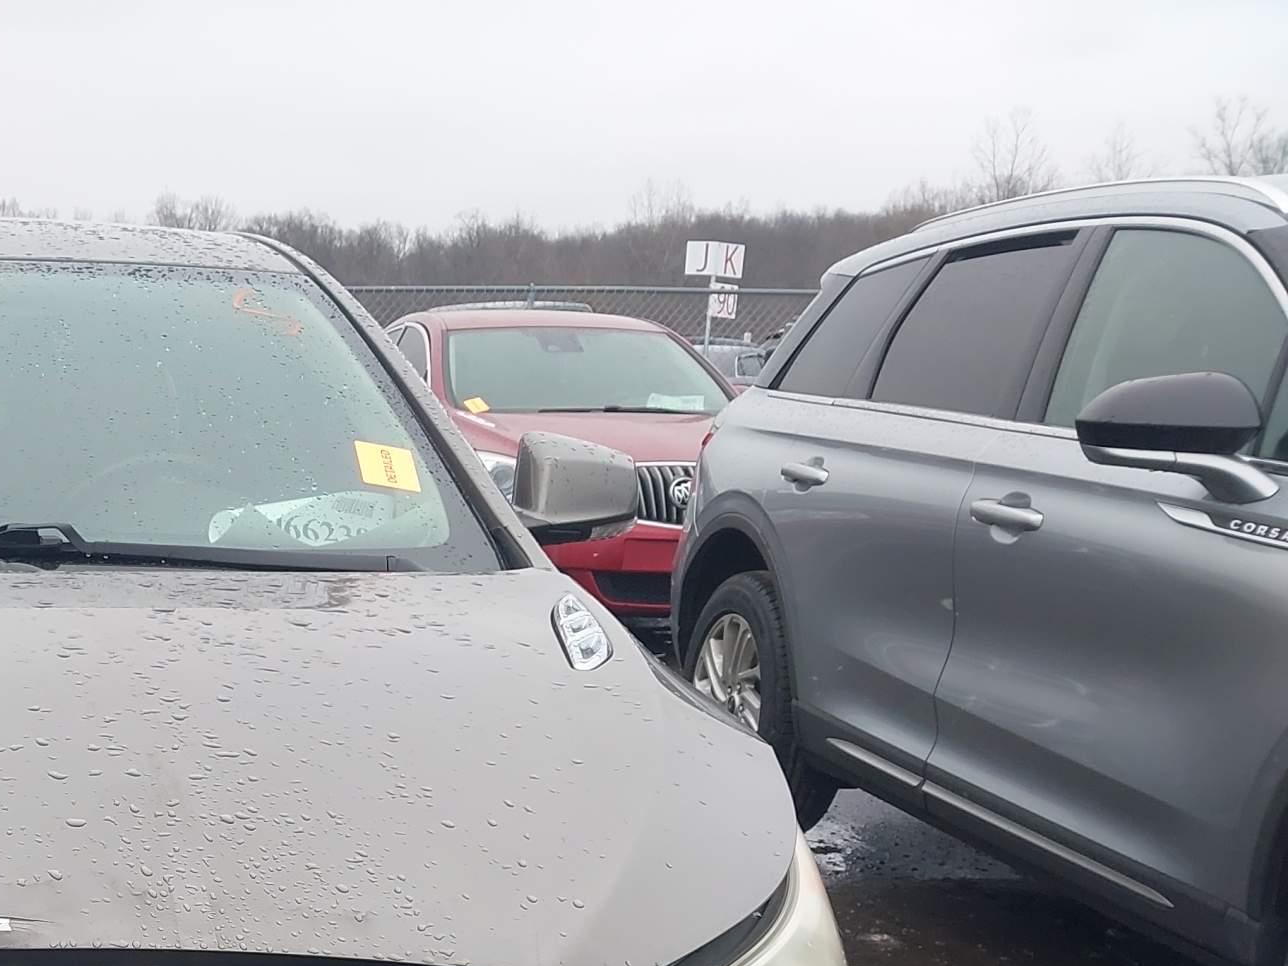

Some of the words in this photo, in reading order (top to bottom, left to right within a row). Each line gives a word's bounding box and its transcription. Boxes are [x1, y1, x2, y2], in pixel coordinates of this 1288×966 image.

[696, 243, 709, 272] J
[723, 245, 739, 275] K
[717, 286, 737, 315] 90
[380, 449, 398, 484] DETAILED
